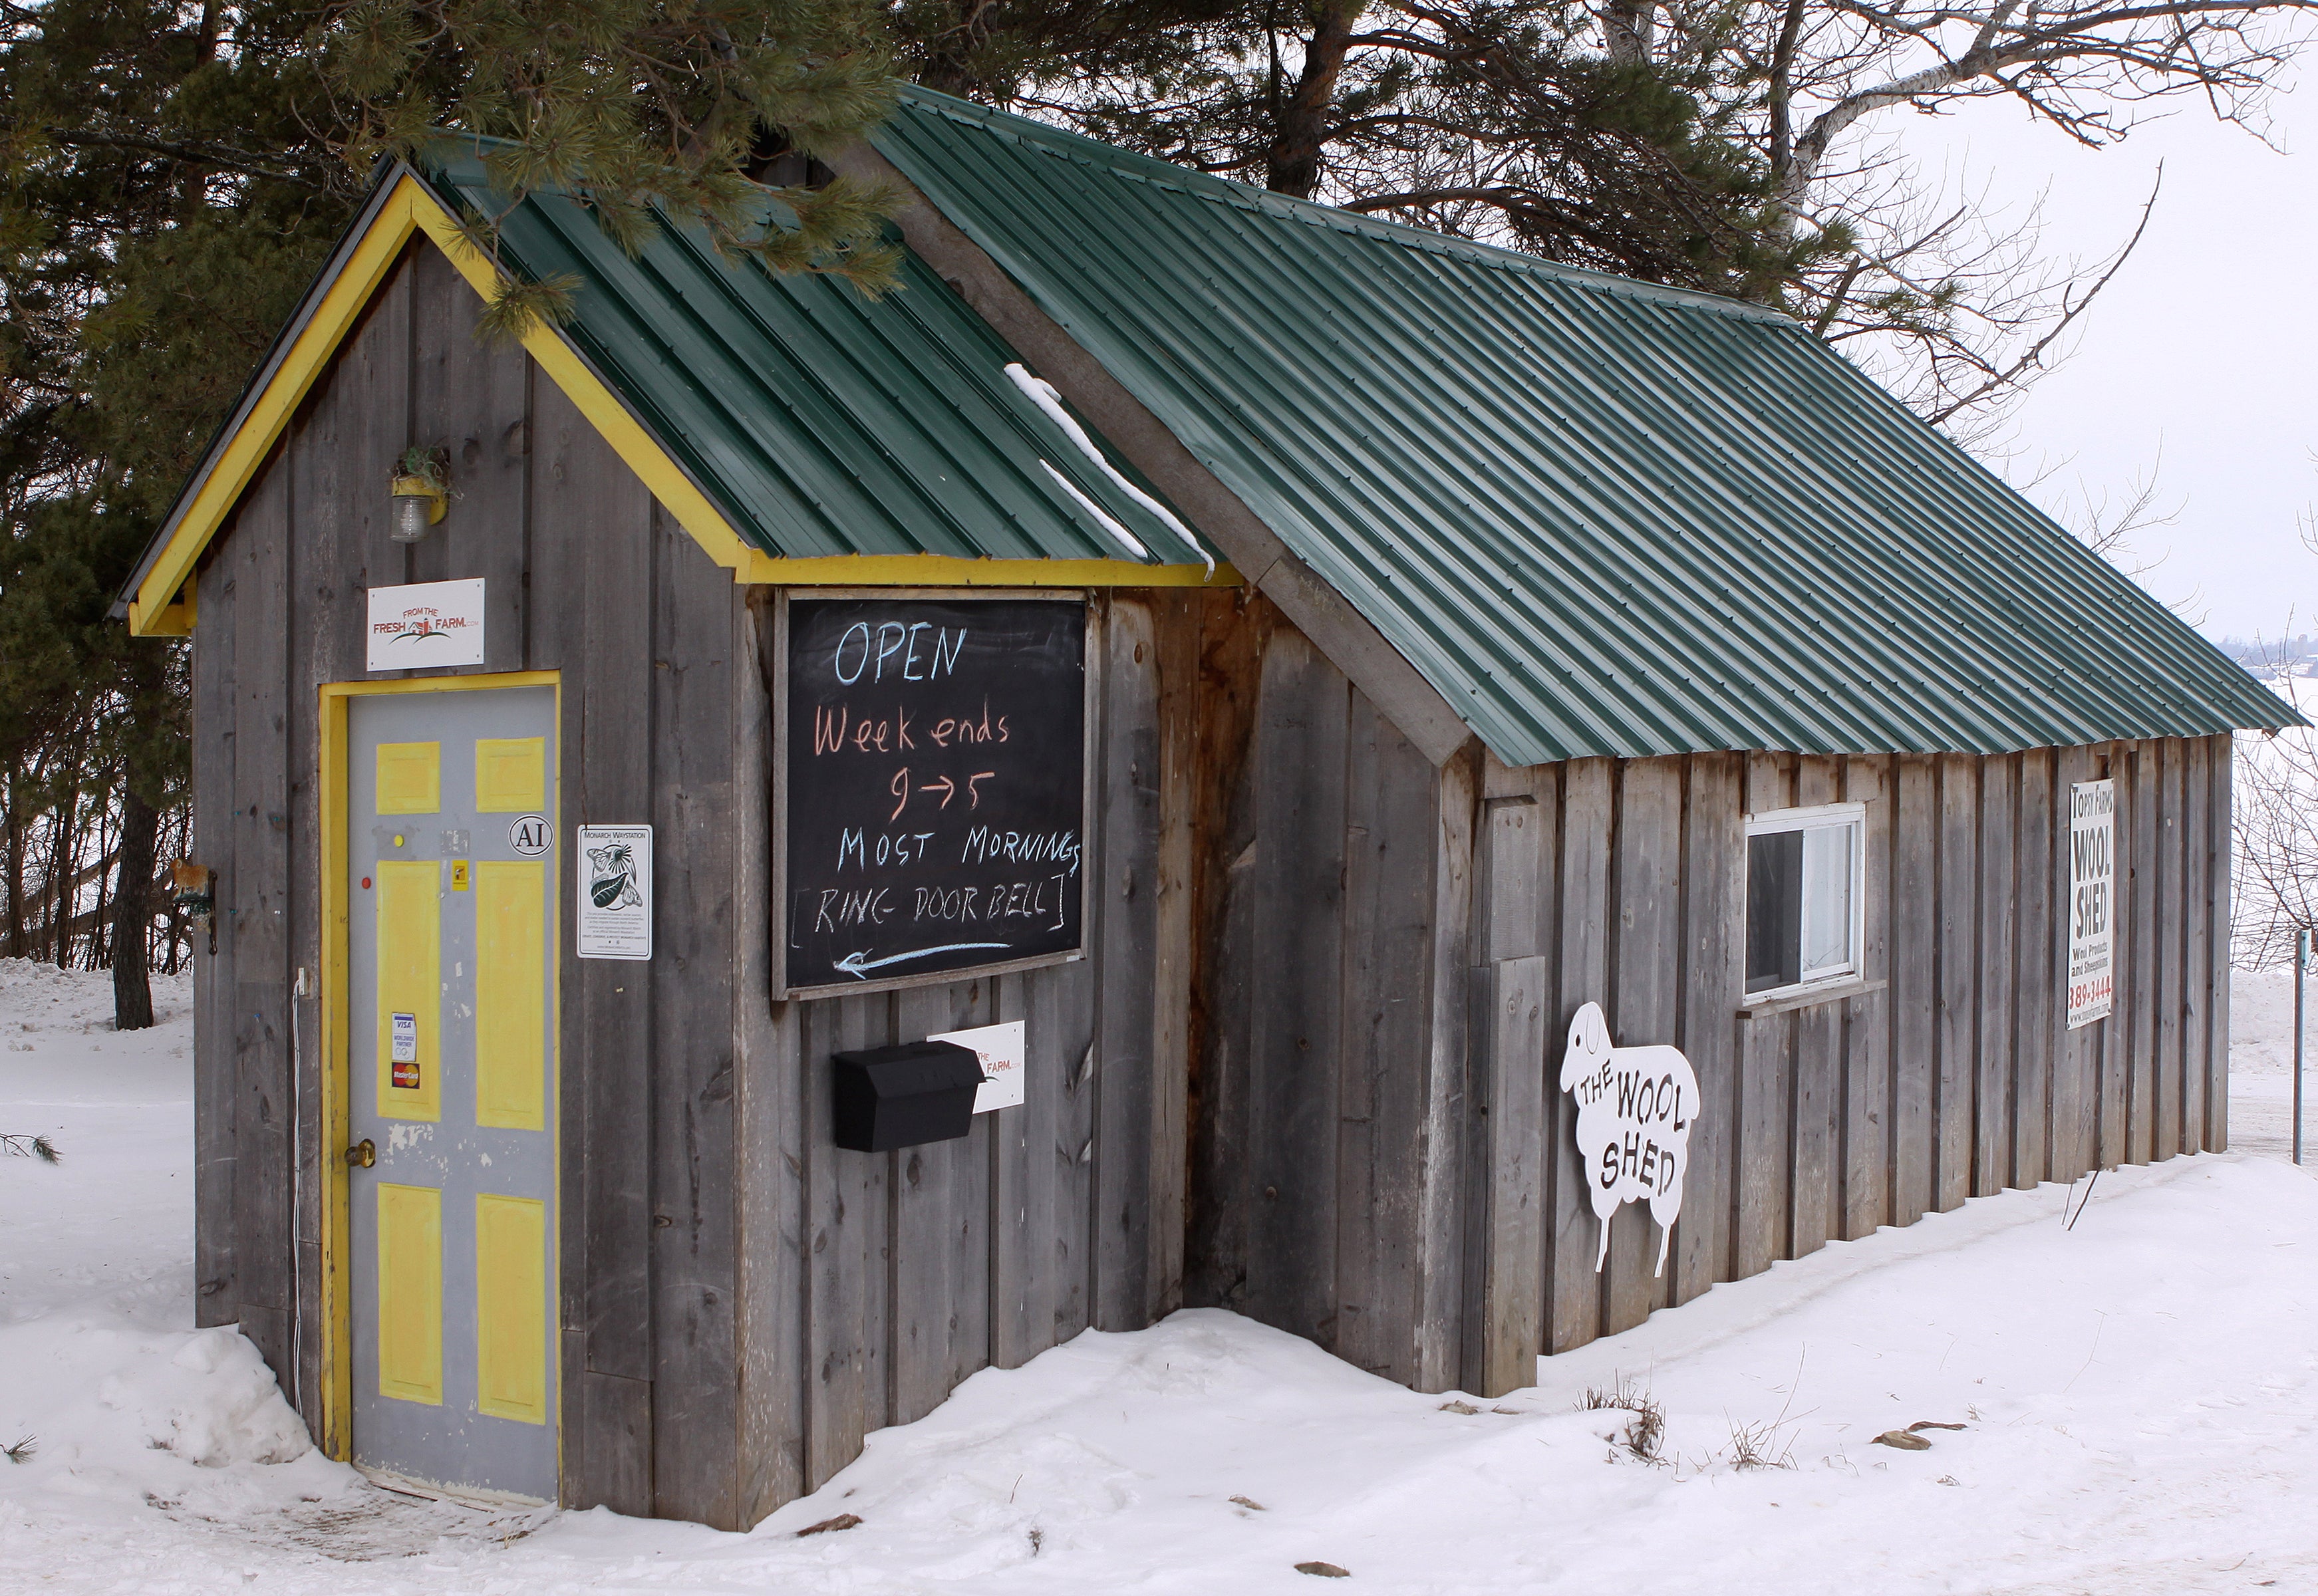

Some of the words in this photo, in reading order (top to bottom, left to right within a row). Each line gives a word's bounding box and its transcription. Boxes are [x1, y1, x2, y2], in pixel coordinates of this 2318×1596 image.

[373, 622, 406, 634] FRESH
[403, 608, 423, 618] FROM
[424, 607, 439, 617] THE
[835, 620, 968, 686] OPEN
[515, 823, 545, 847] AI
[837, 826, 936, 873] MOST
[961, 825, 1082, 878] MORNINGS
[2073, 825, 2110, 883] WOOL
[2076, 882, 2107, 940] SHED
[2071, 962, 2084, 978] and
[2072, 944, 2088, 962] Wool
[2069, 975, 2112, 1010] 389-3444
[978, 1052, 990, 1061] THE
[1580, 1058, 1613, 1105] THE
[1617, 1069, 1686, 1133] WOOL
[1600, 1130, 1675, 1198] SHED
